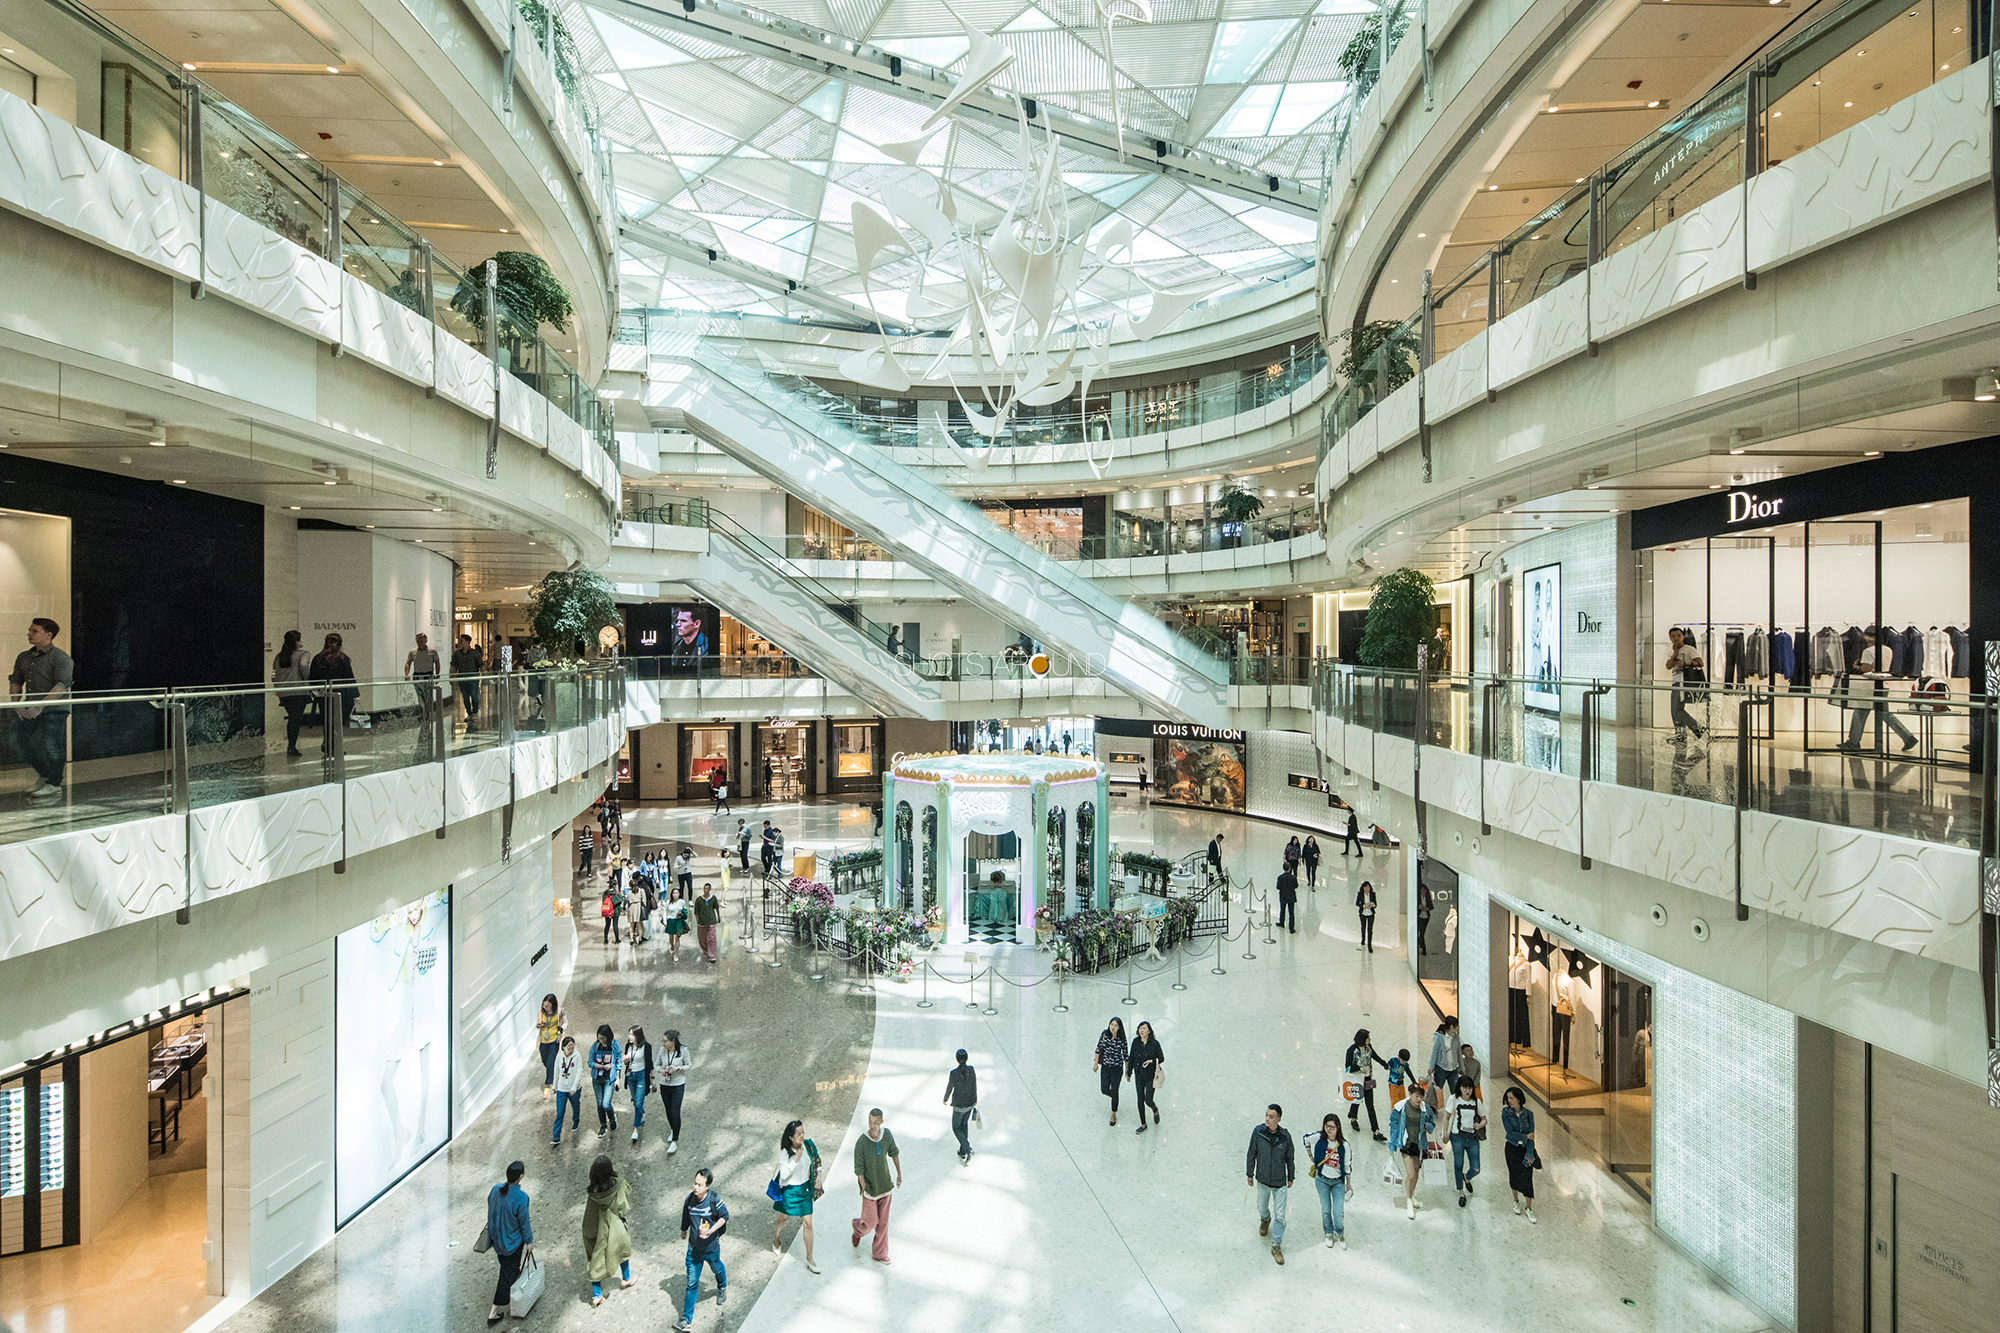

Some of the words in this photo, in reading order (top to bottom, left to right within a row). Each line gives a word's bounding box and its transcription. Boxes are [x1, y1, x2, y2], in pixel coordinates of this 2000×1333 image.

[1726, 491, 1783, 523] Dior
[314, 622, 357, 631] BALMAIN
[1577, 611, 1602, 633] Dior
[770, 719, 799, 728] Cartier
[1153, 724, 1188, 737] LOUIS
[1191, 726, 1242, 740] VUITTON
[1346, 1090, 1360, 1098] kids
